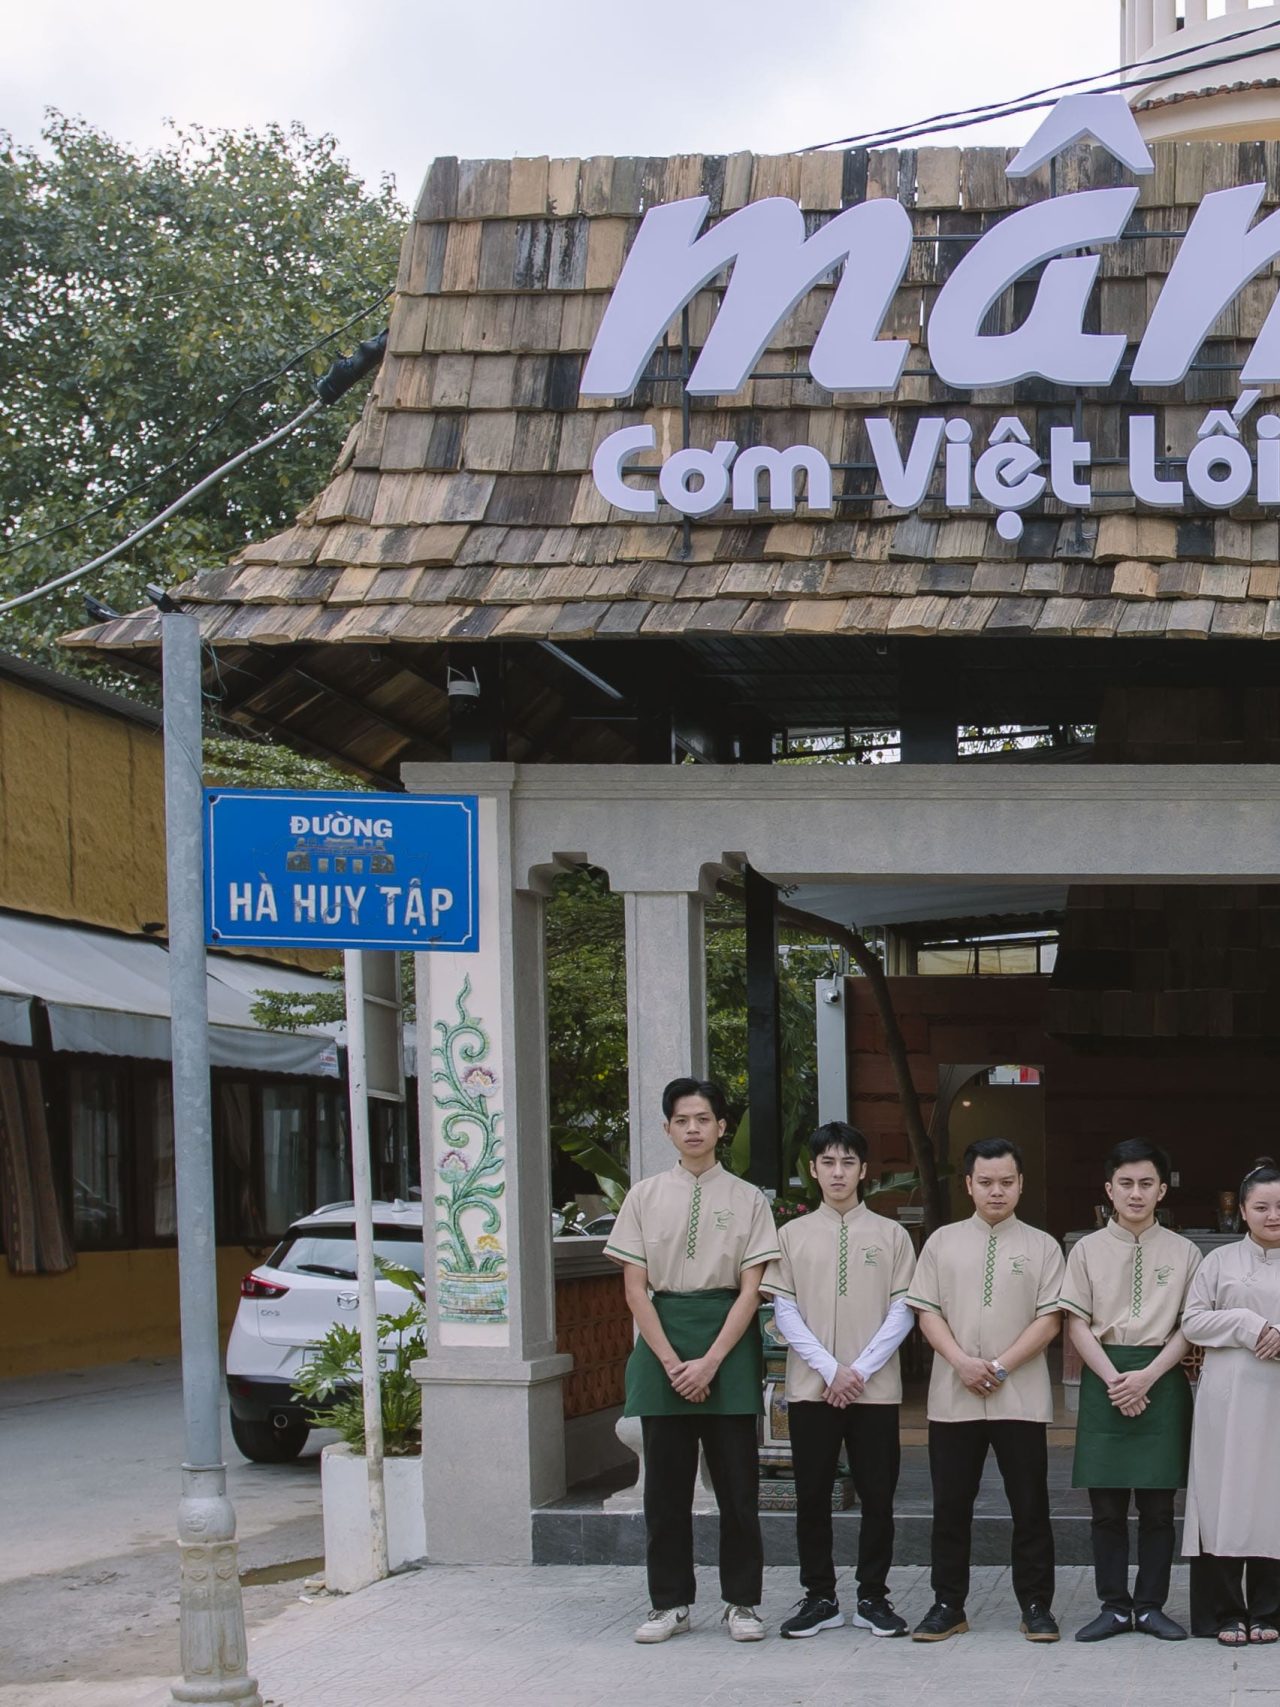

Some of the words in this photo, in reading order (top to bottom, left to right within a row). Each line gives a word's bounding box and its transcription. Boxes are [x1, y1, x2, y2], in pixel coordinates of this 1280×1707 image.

[592, 424, 833, 518] Cơm
[864, 415, 1092, 543] Việt
[289, 811, 393, 838] ĐƯỜNG
[229, 872, 278, 922] HÀ
[294, 884, 366, 925] HUY
[380, 877, 454, 935] TẬP
